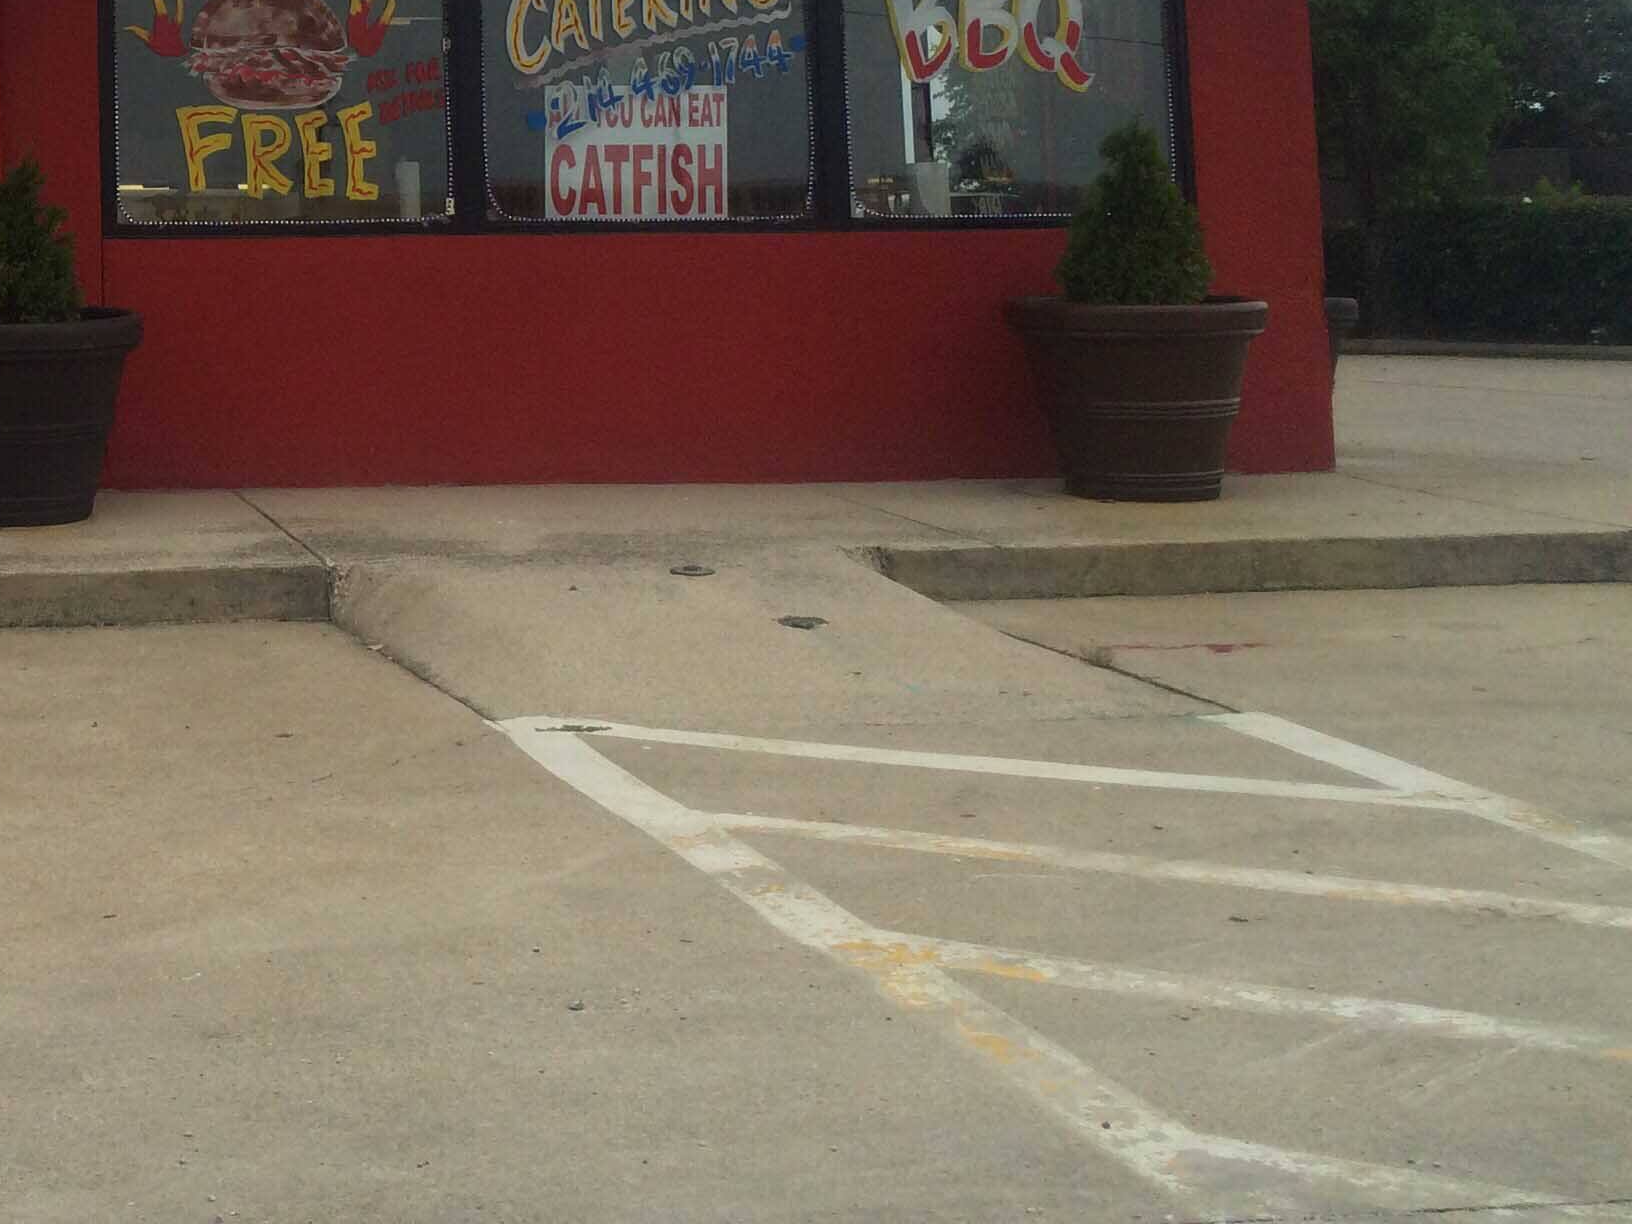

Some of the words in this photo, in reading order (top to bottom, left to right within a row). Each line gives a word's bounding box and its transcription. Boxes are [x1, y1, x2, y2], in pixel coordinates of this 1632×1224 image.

[550, 66, 625, 142] 214
[639, 93, 681, 128] CAN
[687, 92, 725, 128] EAT
[176, 101, 379, 201] FREE
[549, 142, 724, 218] CATFISH
